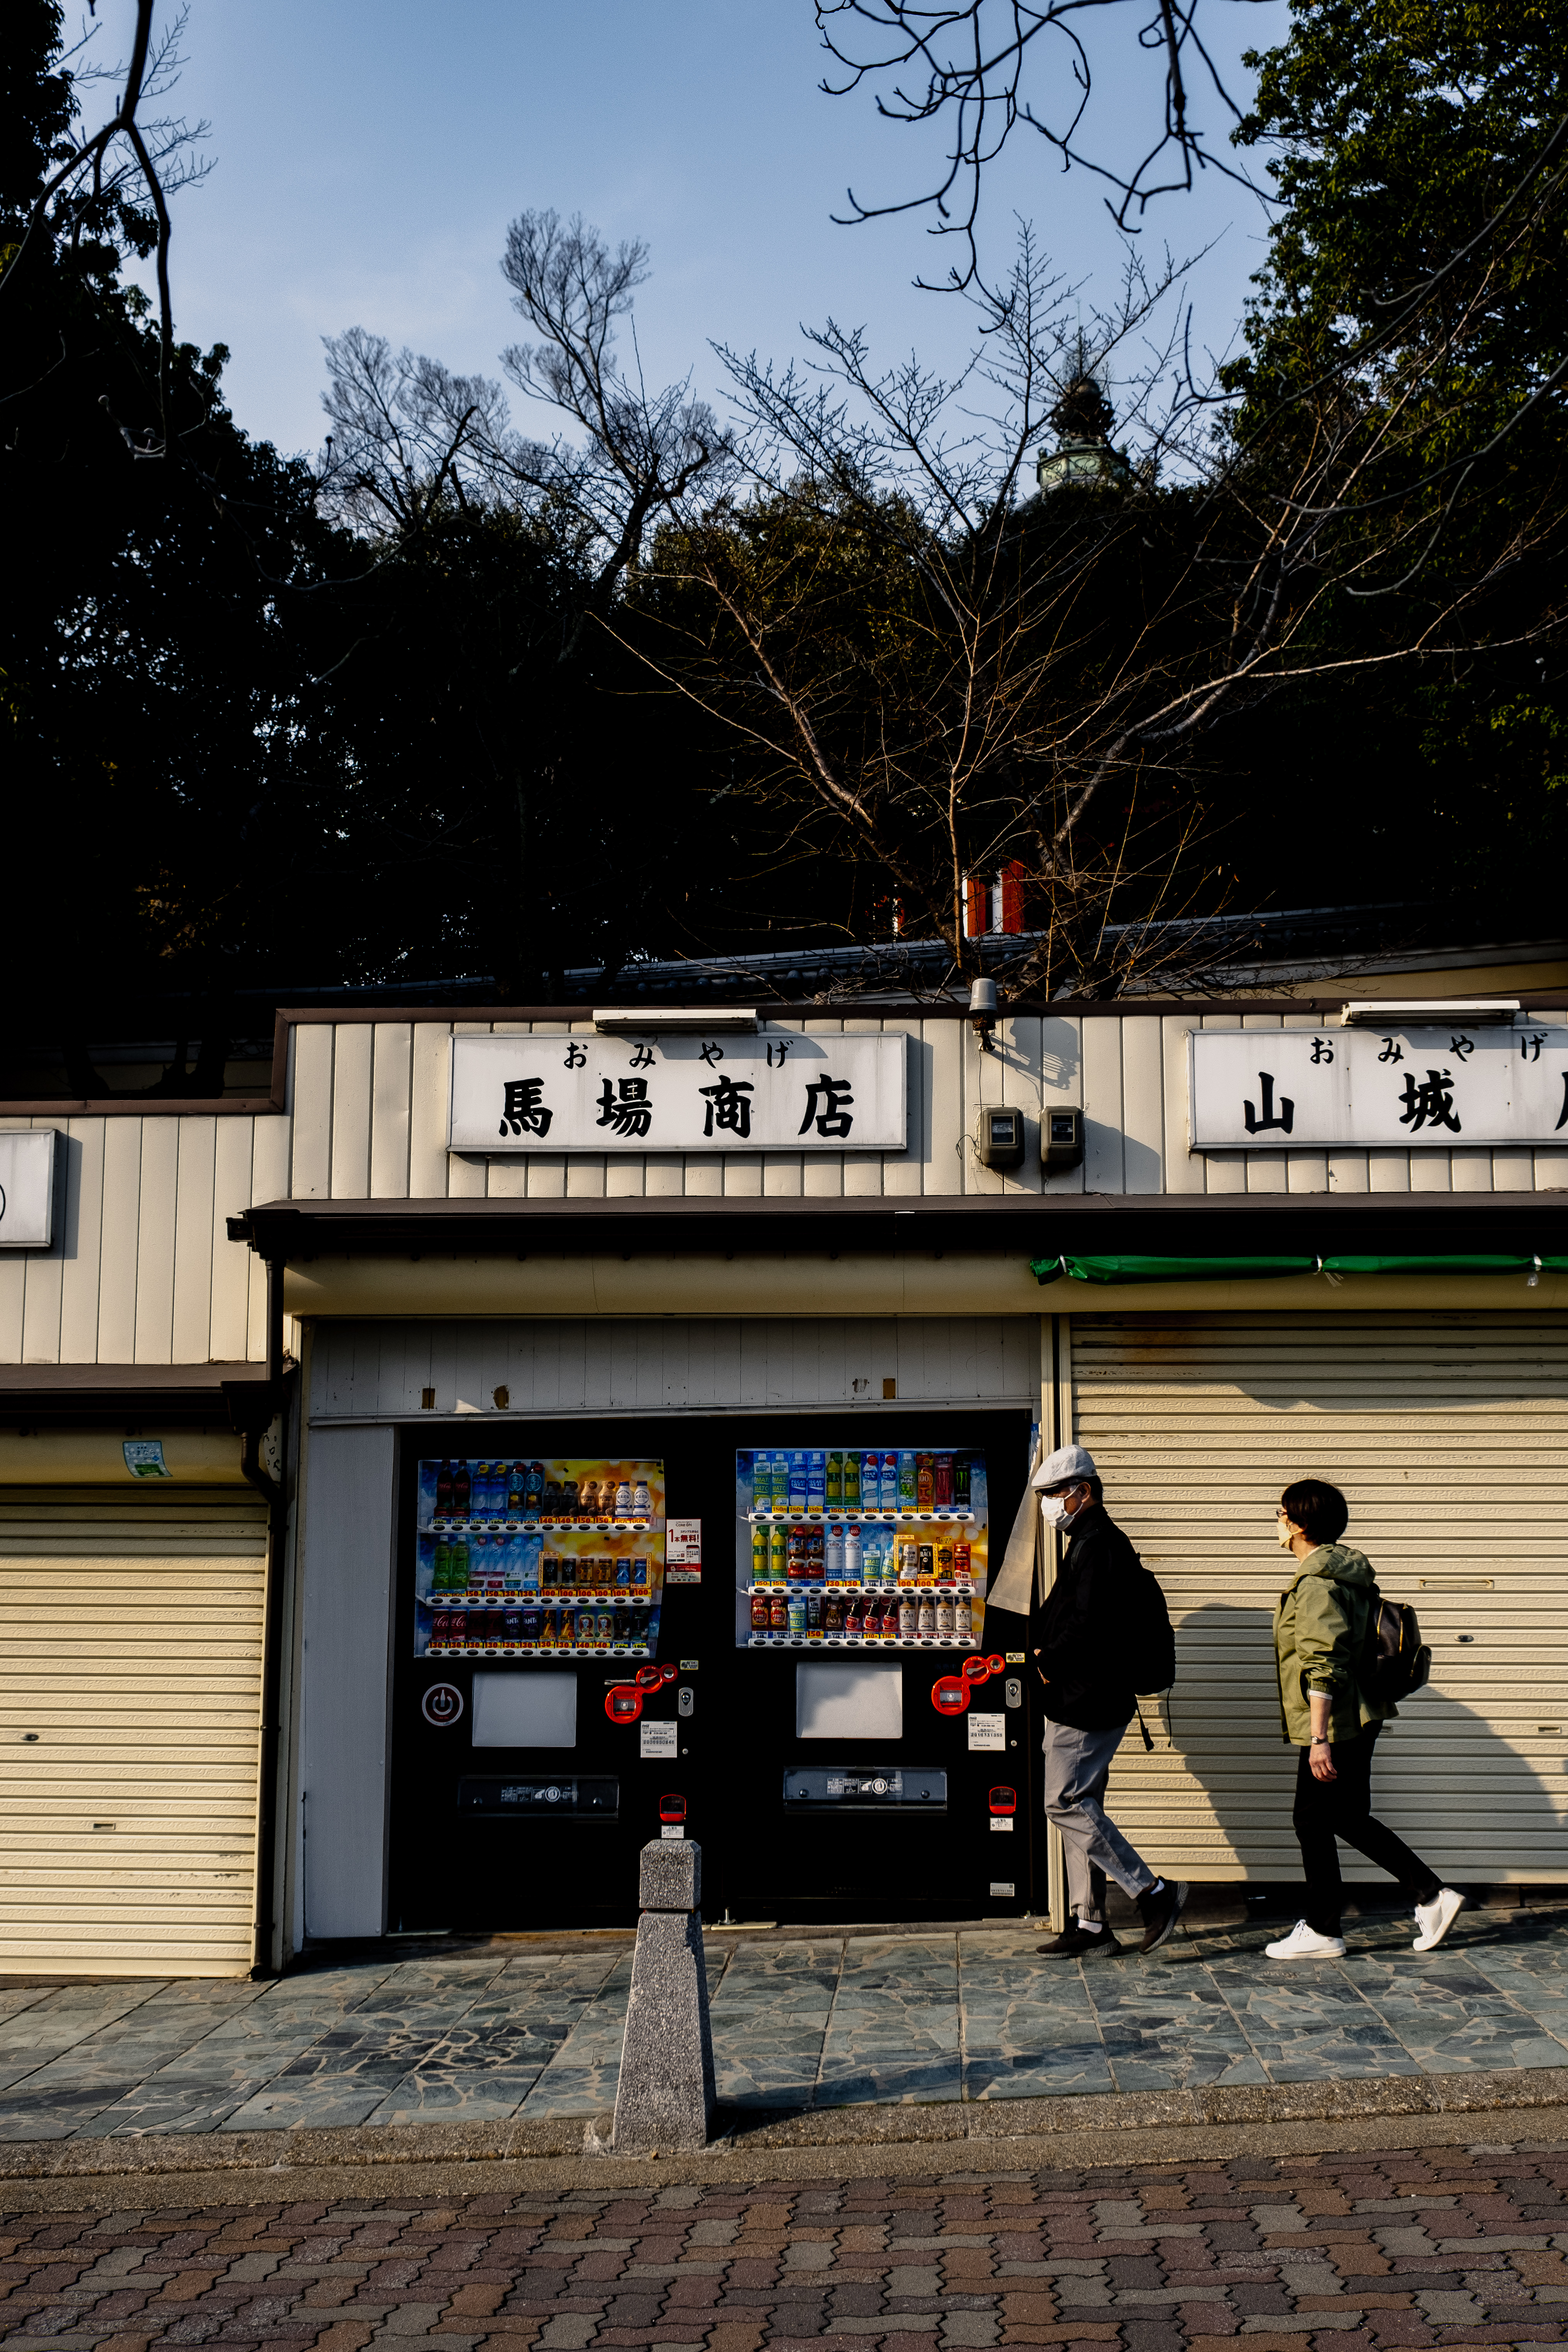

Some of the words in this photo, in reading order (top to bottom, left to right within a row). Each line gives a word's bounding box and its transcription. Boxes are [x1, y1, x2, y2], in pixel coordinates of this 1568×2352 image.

[563, 1040, 794, 1070] おみやげ
[1310, 1032, 1548, 1064] おみやげ
[498, 1073, 854, 1138] 馬場商店
